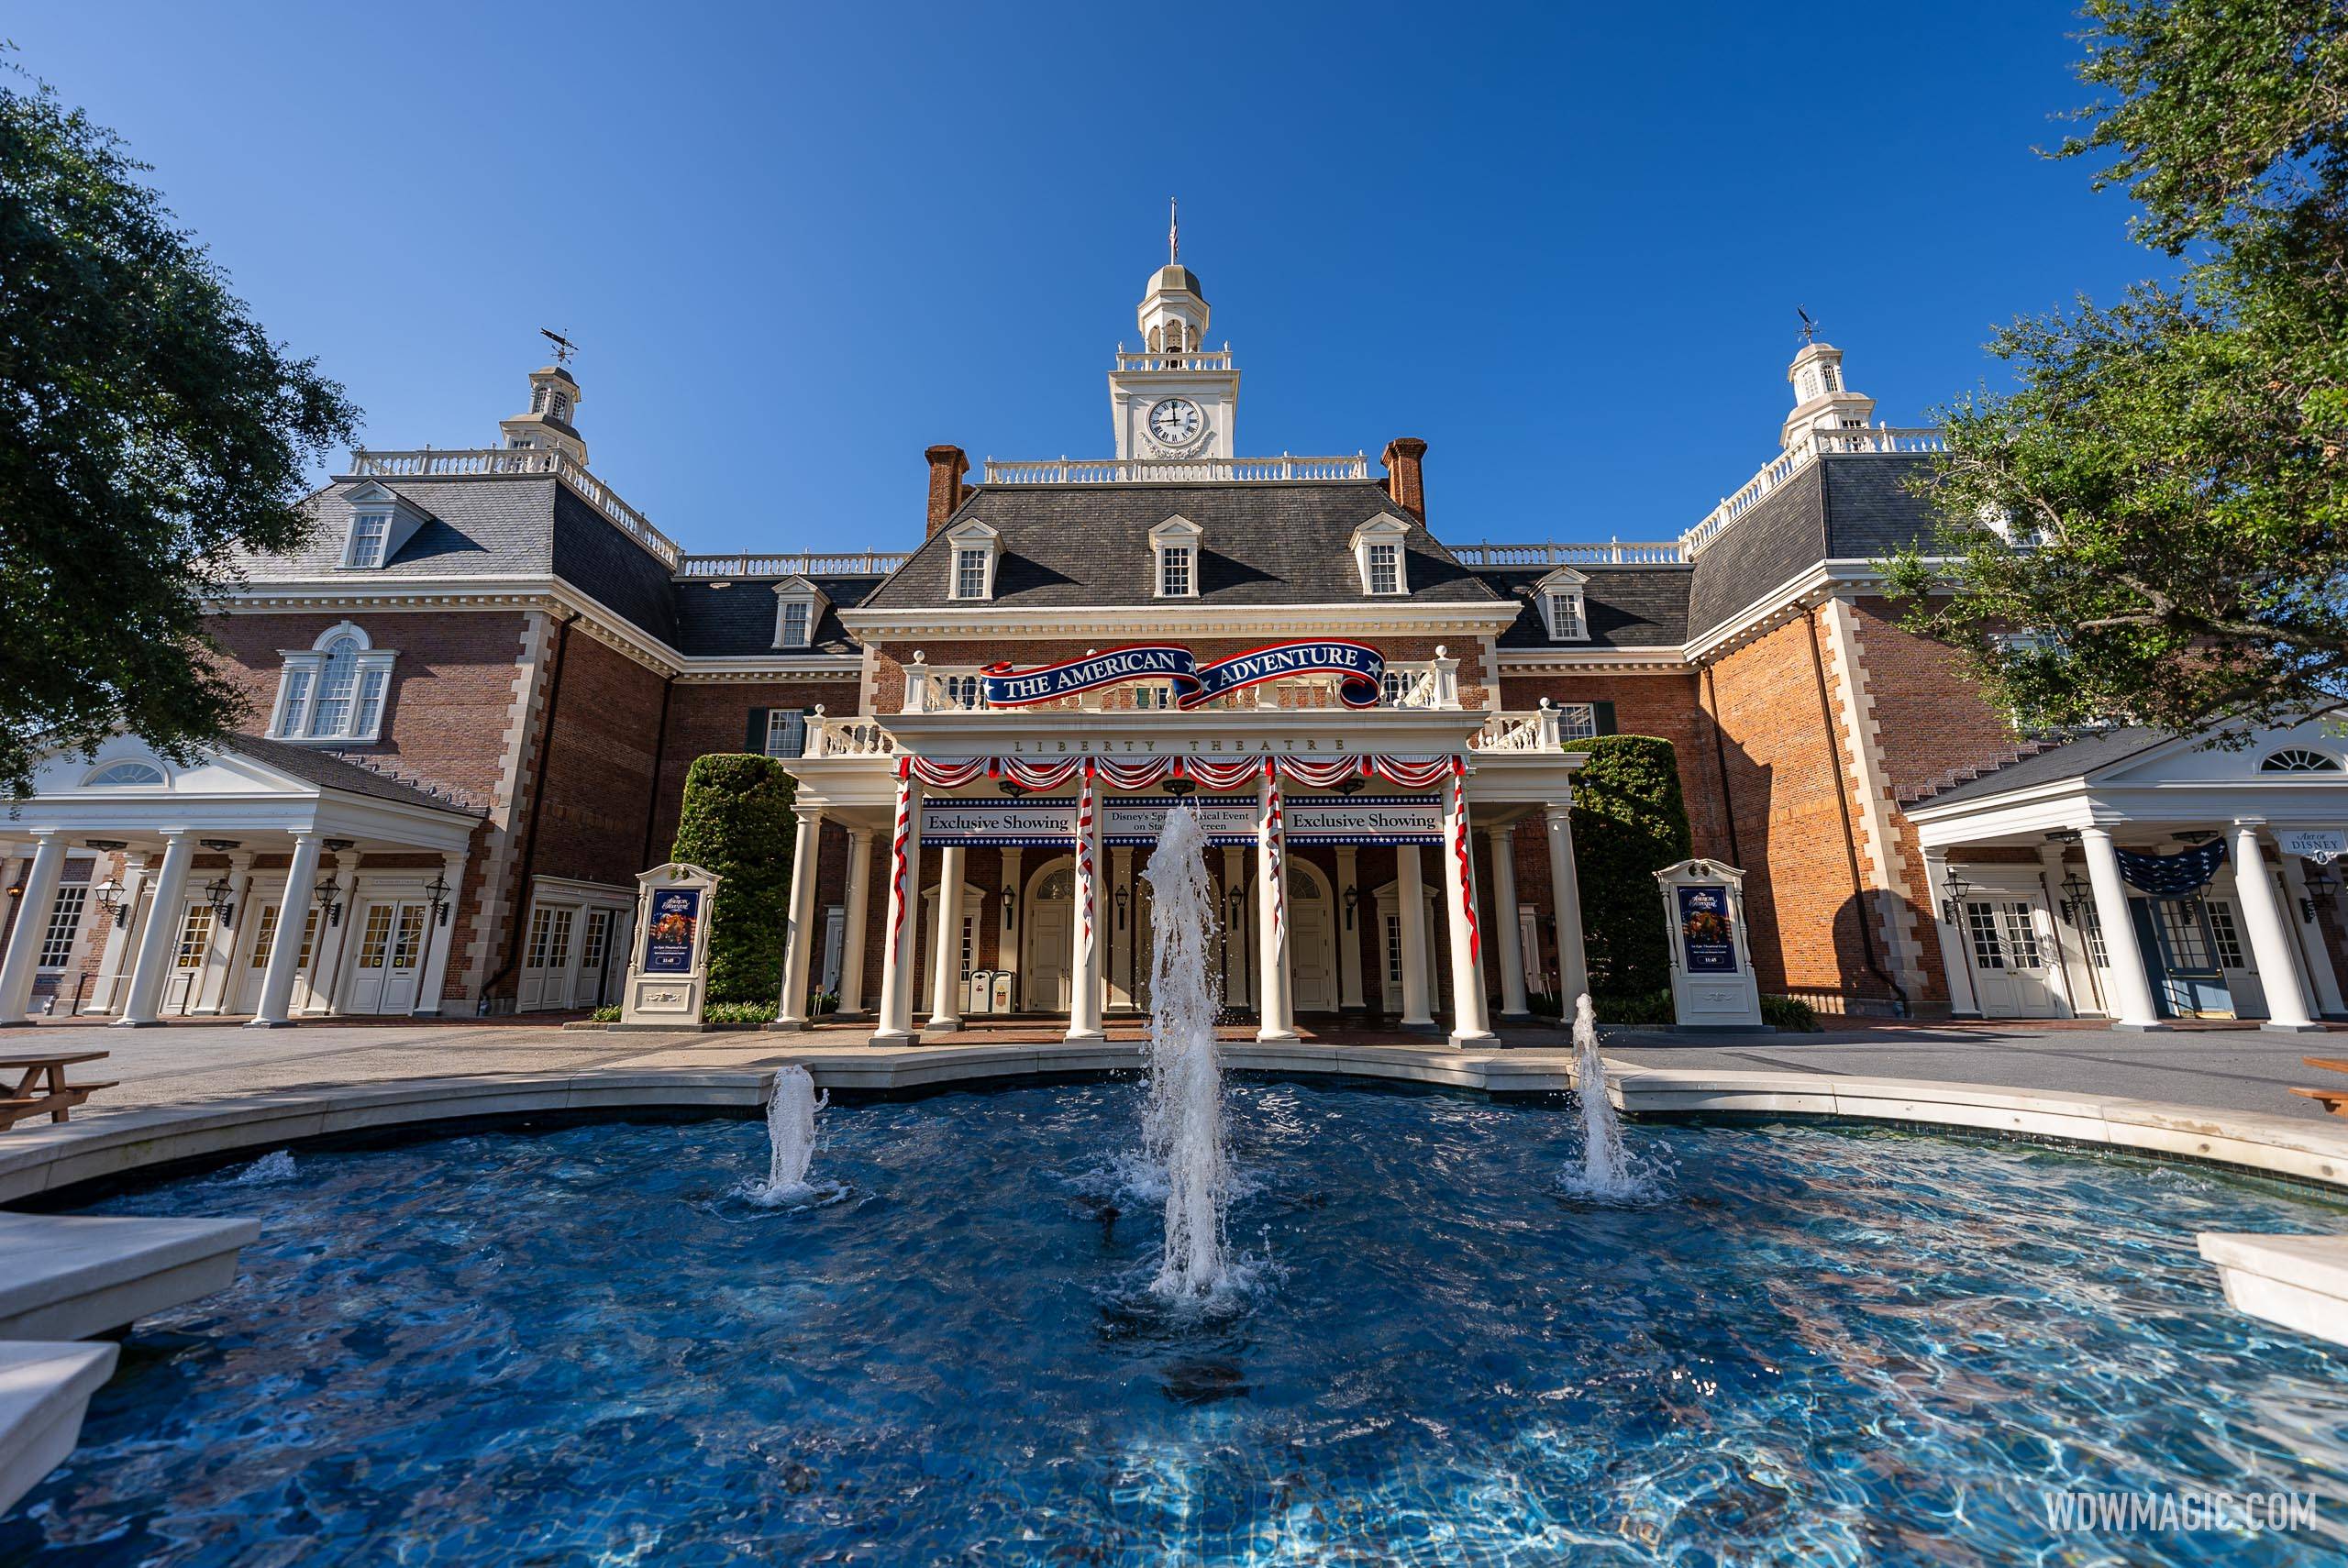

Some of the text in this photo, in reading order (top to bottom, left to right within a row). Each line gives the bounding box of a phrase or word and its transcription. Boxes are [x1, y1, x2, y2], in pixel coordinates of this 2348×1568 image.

[1003, 646, 1358, 700] THE AMERICAN ADVENTURE
[1014, 739, 1345, 752] LIBERTY THEATRE
[928, 815, 1069, 832] Exclusive Showing
[1112, 812, 1149, 823] Disney's
[1151, 812, 1168, 823] Epi
[1223, 812, 1249, 820] Event
[1292, 813, 1436, 830] Exclusive Showing
[1198, 823, 1227, 831] creen
[2291, 840, 2338, 849] DISNEY
